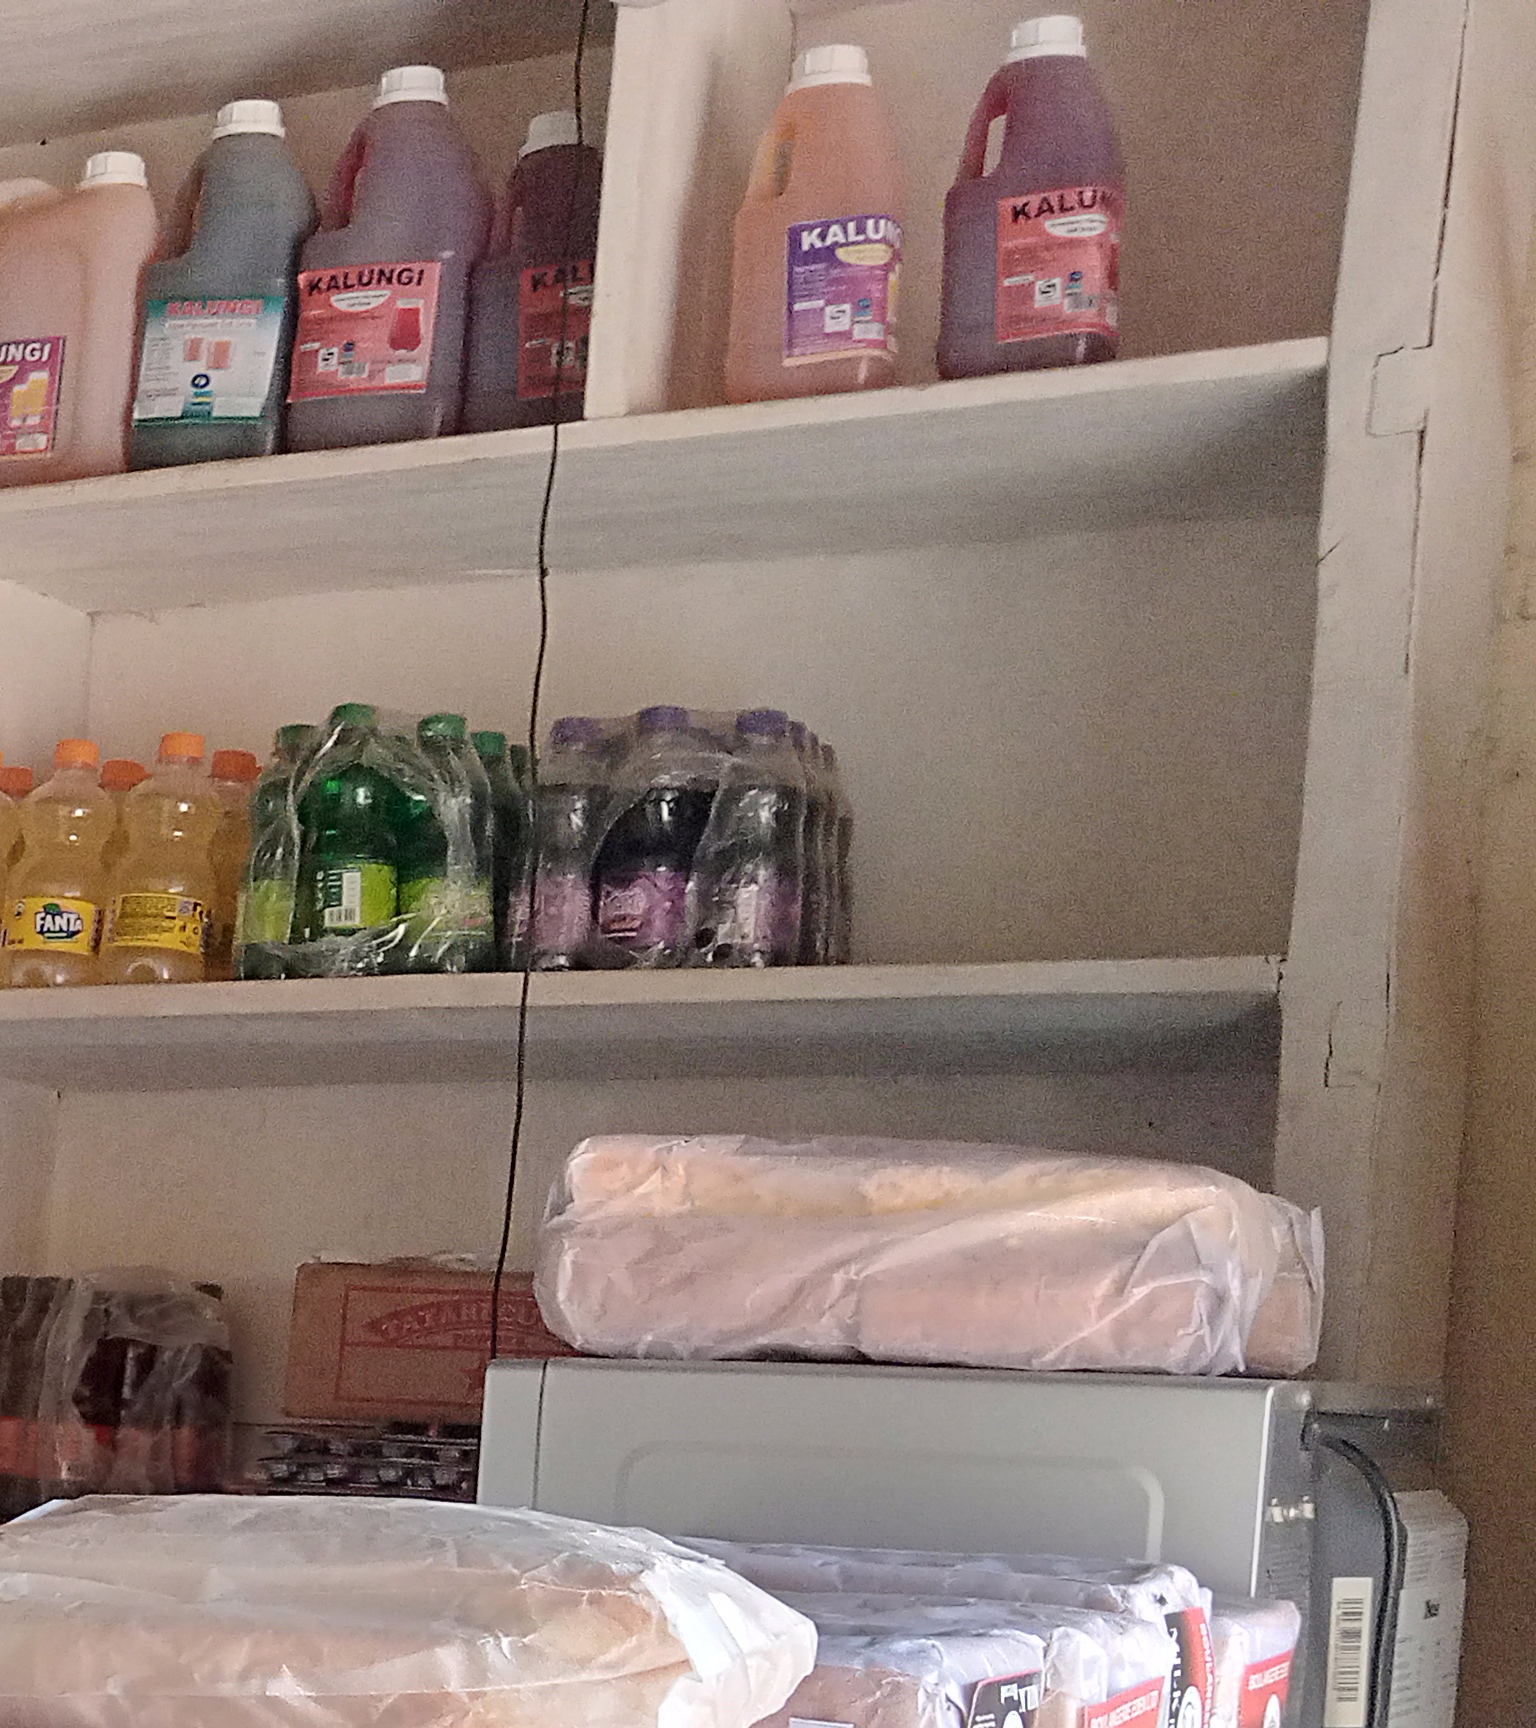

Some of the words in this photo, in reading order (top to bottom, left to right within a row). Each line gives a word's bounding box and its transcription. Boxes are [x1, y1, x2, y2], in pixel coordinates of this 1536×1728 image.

[307, 266, 425, 297] KALUNGI
[166, 300, 264, 317] KALUNGI
[34, 911, 84, 933] FANTA
